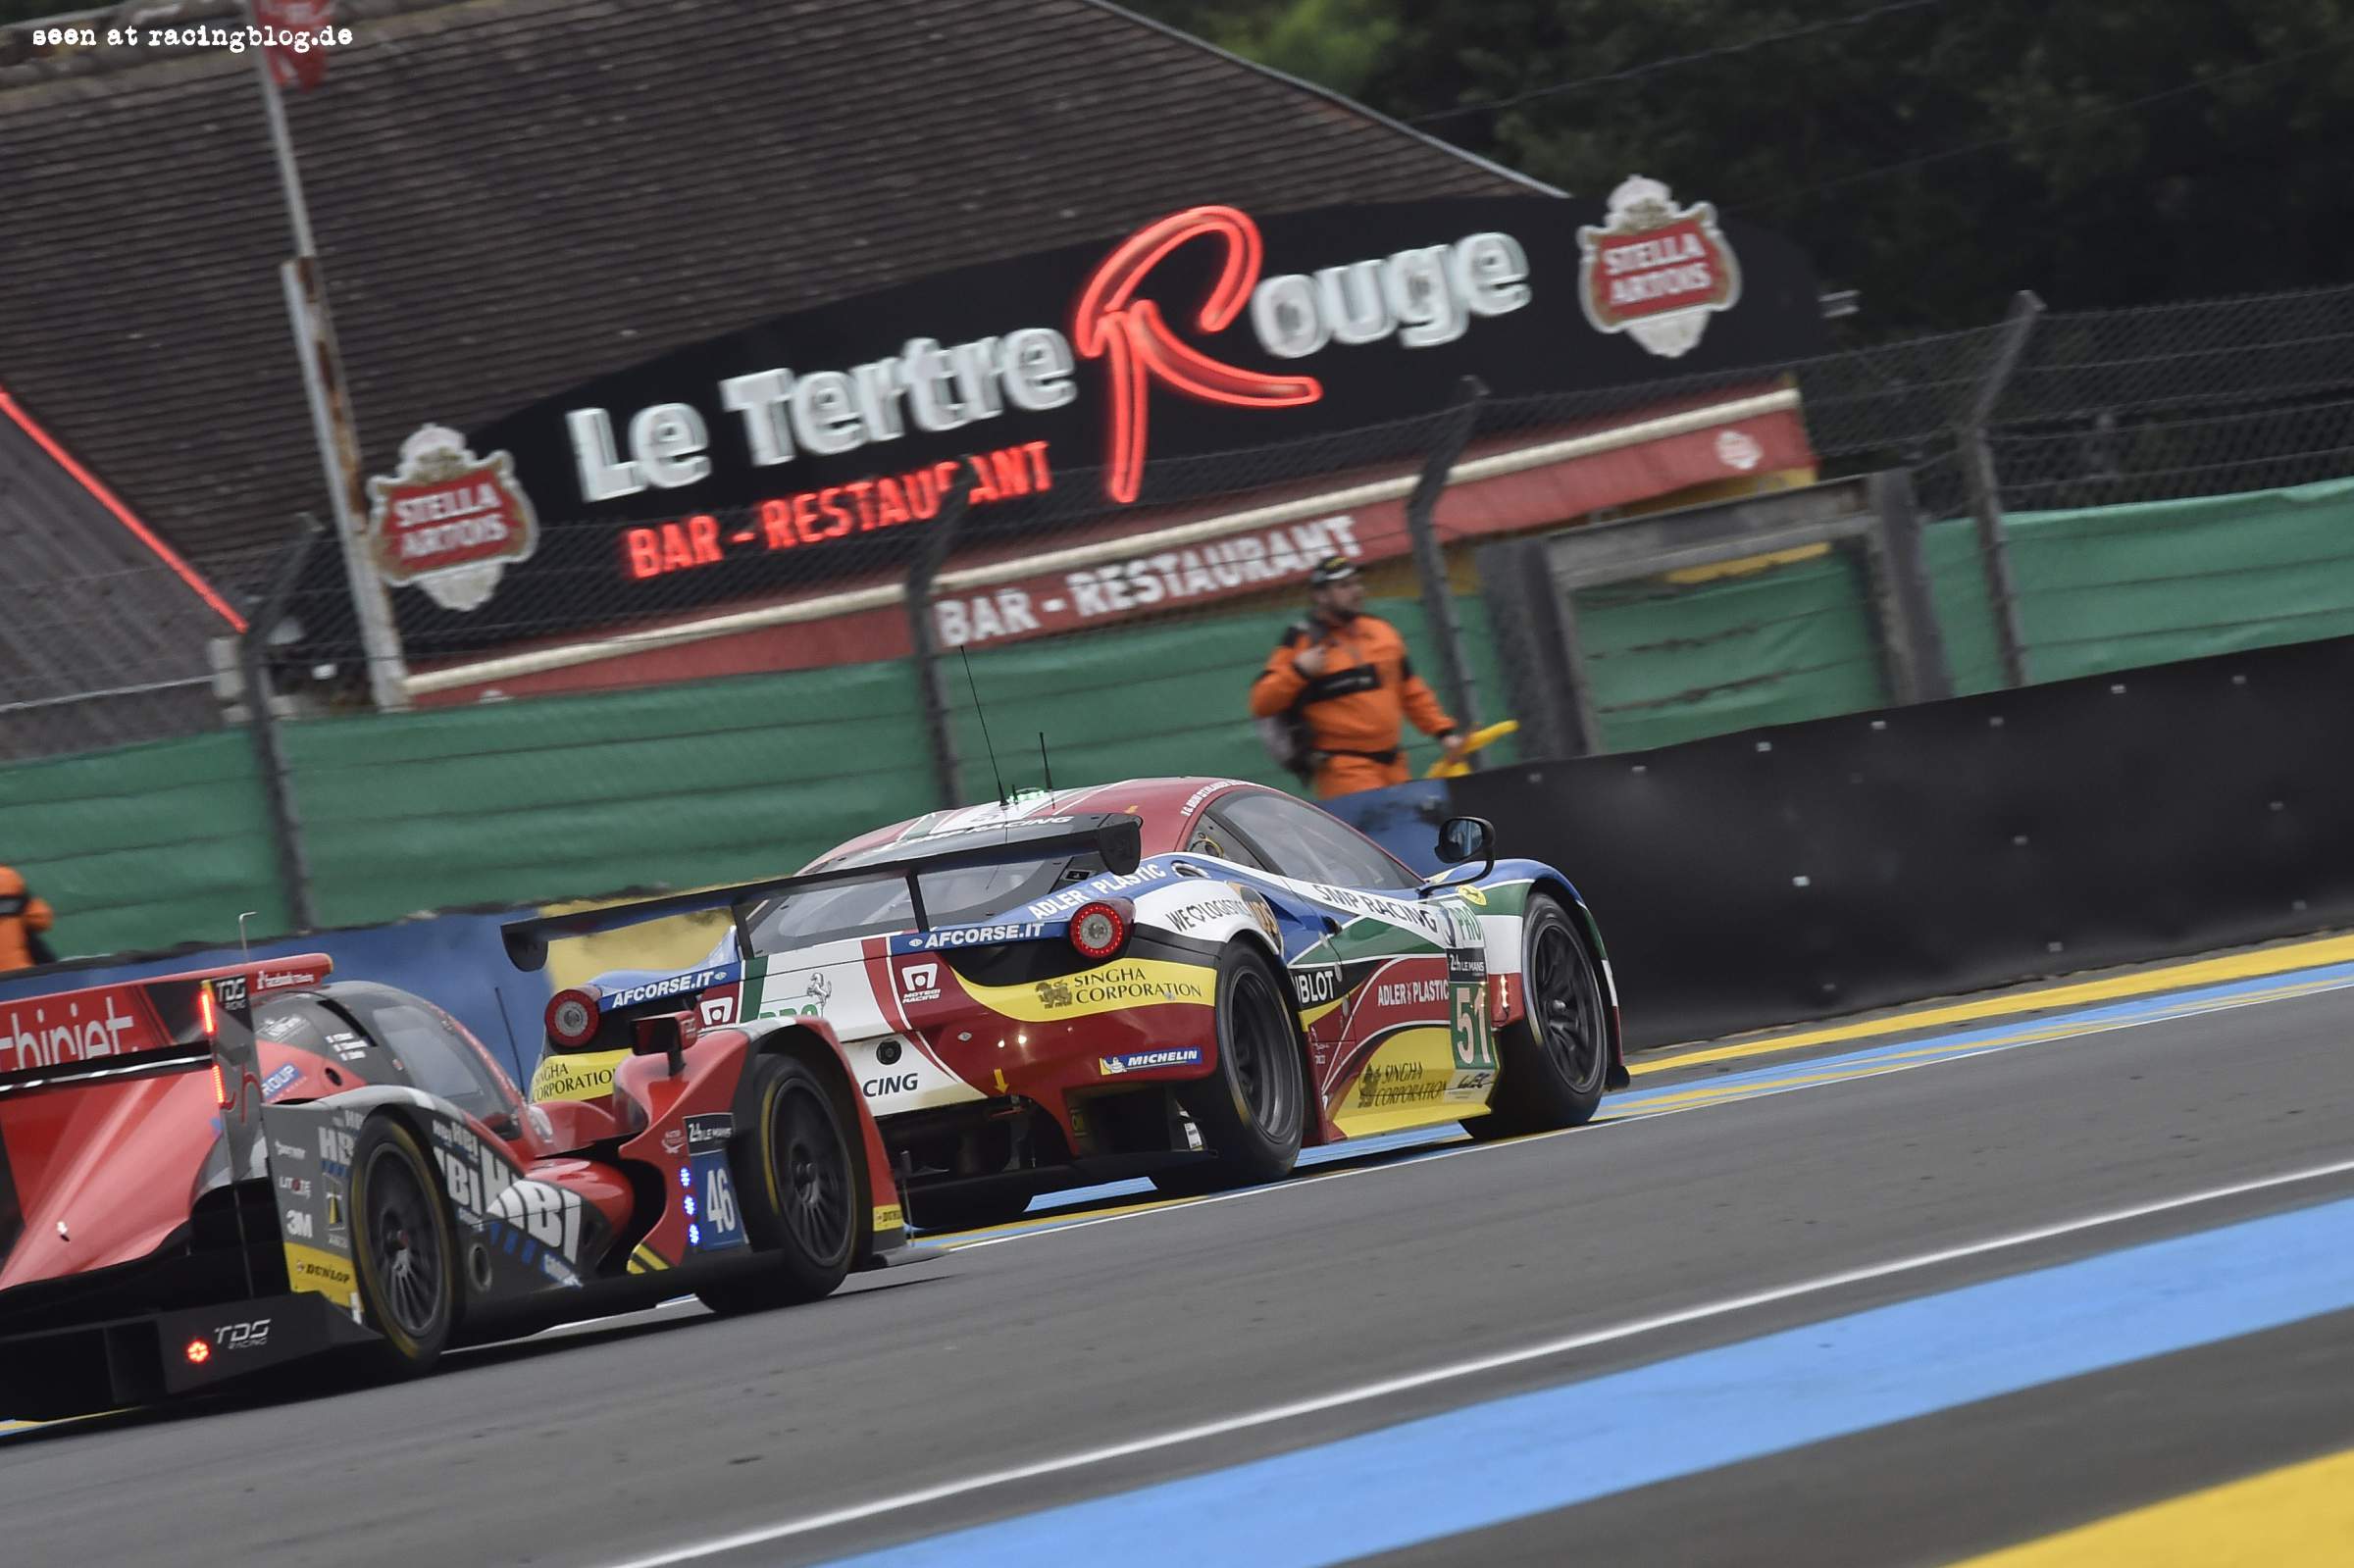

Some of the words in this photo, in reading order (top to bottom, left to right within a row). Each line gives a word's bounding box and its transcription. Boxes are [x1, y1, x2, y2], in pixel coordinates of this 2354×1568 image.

[1603, 232, 1706, 276] STELLA
[1610, 262, 1713, 307] ARTOIS
[566, 400, 712, 502] Le
[719, 328, 1077, 468] Tertre
[1075, 204, 1532, 504] Rouge
[393, 482, 503, 528] STELLA
[400, 513, 508, 559] ARTOIS
[625, 513, 724, 580] BAR
[935, 587, 1042, 647] BAR
[1065, 515, 1362, 617] RESTAURANT
[1027, 888, 1092, 920] ADLER
[1090, 863, 1166, 894] PLASTIC
[1312, 885, 1359, 909] SMP
[1358, 894, 1438, 934] RACING
[925, 922, 1045, 949] AFCORSE.IT
[1165, 908, 1196, 933] WE
[612, 972, 714, 1008] AFCORSE.IT
[1073, 967, 1147, 987] SINGHA
[1076, 982, 1203, 1004] CORPORATION
[1377, 984, 1407, 1006] ADLER
[1412, 980, 1450, 1003] PLASTIC
[0, 996, 134, 1071] hiriet
[1456, 986, 1492, 1064] 51
[1127, 1049, 1198, 1067] MICHELIN
[1382, 1061, 1423, 1084] SINGHA
[261, 1063, 296, 1097] ROUP
[707, 1168, 736, 1234] 46
[285, 1209, 313, 1239] 3M
[306, 1263, 350, 1284] DUNLOP
[215, 1318, 271, 1344] TDS
